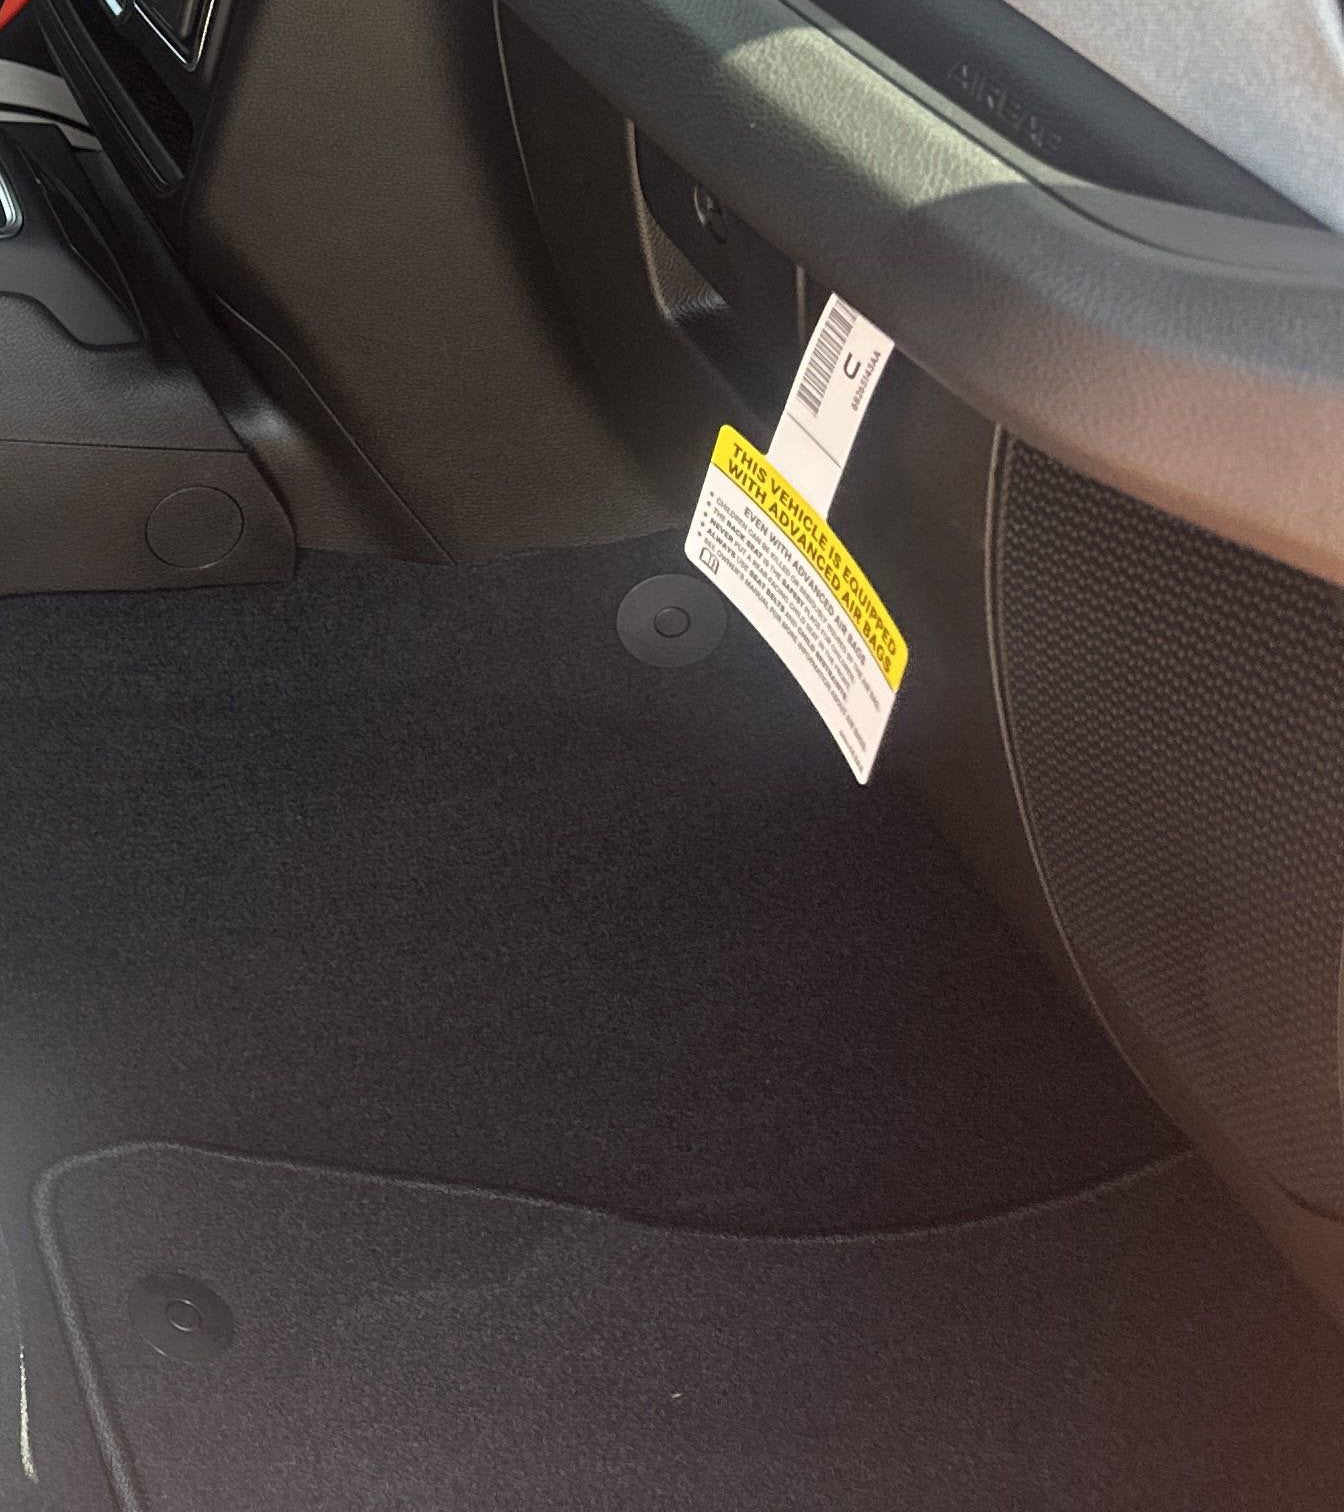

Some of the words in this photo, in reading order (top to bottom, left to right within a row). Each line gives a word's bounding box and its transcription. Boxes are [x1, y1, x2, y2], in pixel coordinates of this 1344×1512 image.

[945, 59, 1063, 151] AIRBAG
[706, 528, 735, 558] ALWAYS
[749, 569, 765, 589] SEAT
[765, 588, 784, 612] BELTS
[710, 517, 733, 542] NEVER
[713, 506, 725, 521] THE
[726, 520, 745, 541] BACK
[745, 540, 762, 558] SEAT
[728, 459, 766, 503] WITH
[769, 503, 840, 590] ADVANCED
[841, 591, 861, 623] AIR
[862, 620, 890, 672] BAGS
[734, 443, 766, 482] THIS
[771, 478, 827, 550] VEHICLE
[828, 546, 841, 569] IS
[842, 566, 895, 654] EQUIPPED
[744, 507, 768, 535] EVEN
[769, 532, 791, 561] WITH
[792, 560, 833, 615] ADVANCED
[834, 615, 847, 635] AIR
[847, 633, 865, 665] BAGS
